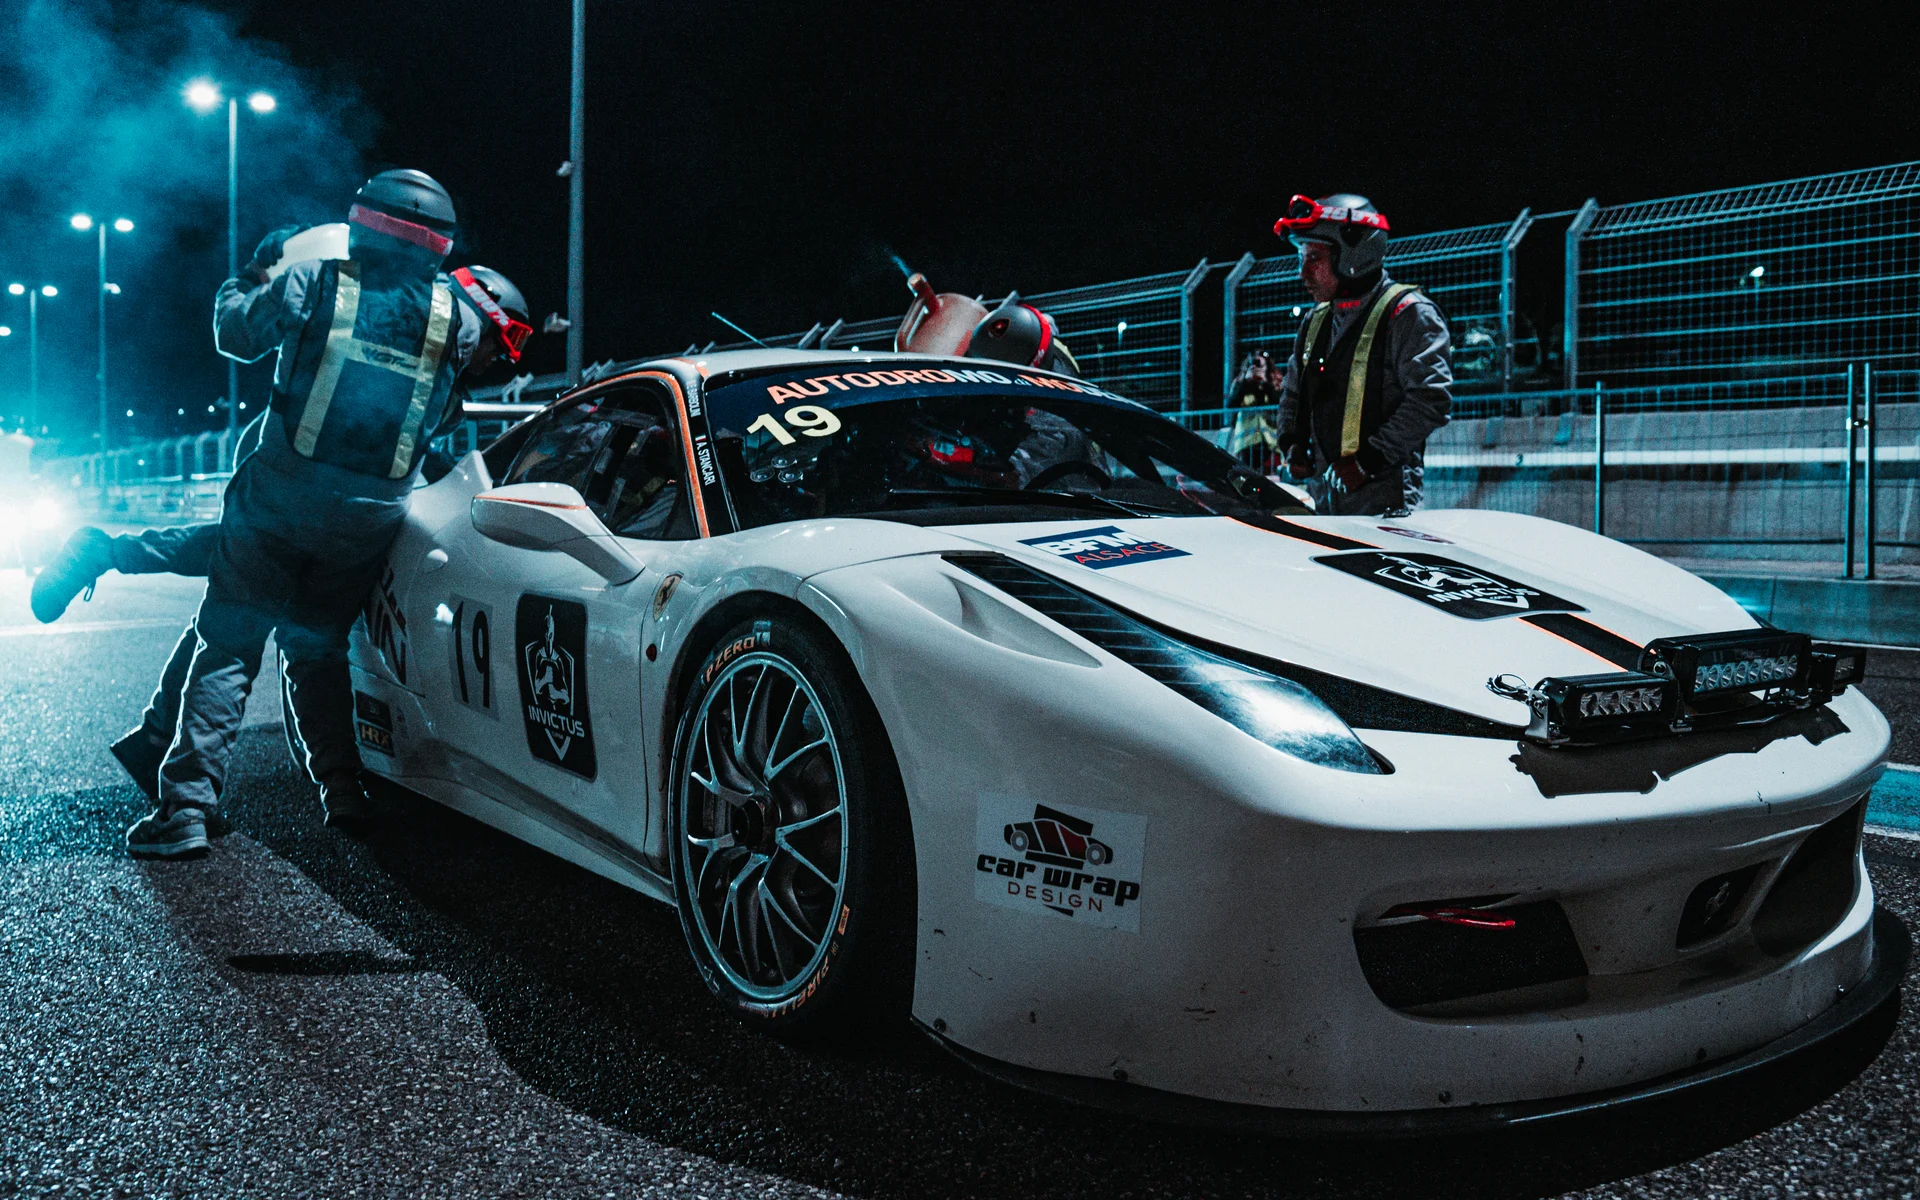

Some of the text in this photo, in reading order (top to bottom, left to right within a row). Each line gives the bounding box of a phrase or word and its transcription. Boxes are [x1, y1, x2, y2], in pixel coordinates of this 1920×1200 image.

[767, 369, 1013, 405] AUTODROMO
[746, 405, 842, 446] 19
[698, 449, 716, 486] STANCARI
[1031, 532, 1152, 556] BFM
[1074, 543, 1178, 565] ALSACE
[1427, 587, 1541, 603] INVICTUS
[452, 600, 490, 709] 19
[706, 636, 756, 683] P ZERO
[528, 704, 585, 738] INVICTUS
[976, 854, 1140, 907] car wrap
[1007, 881, 1103, 912] DESIGN
